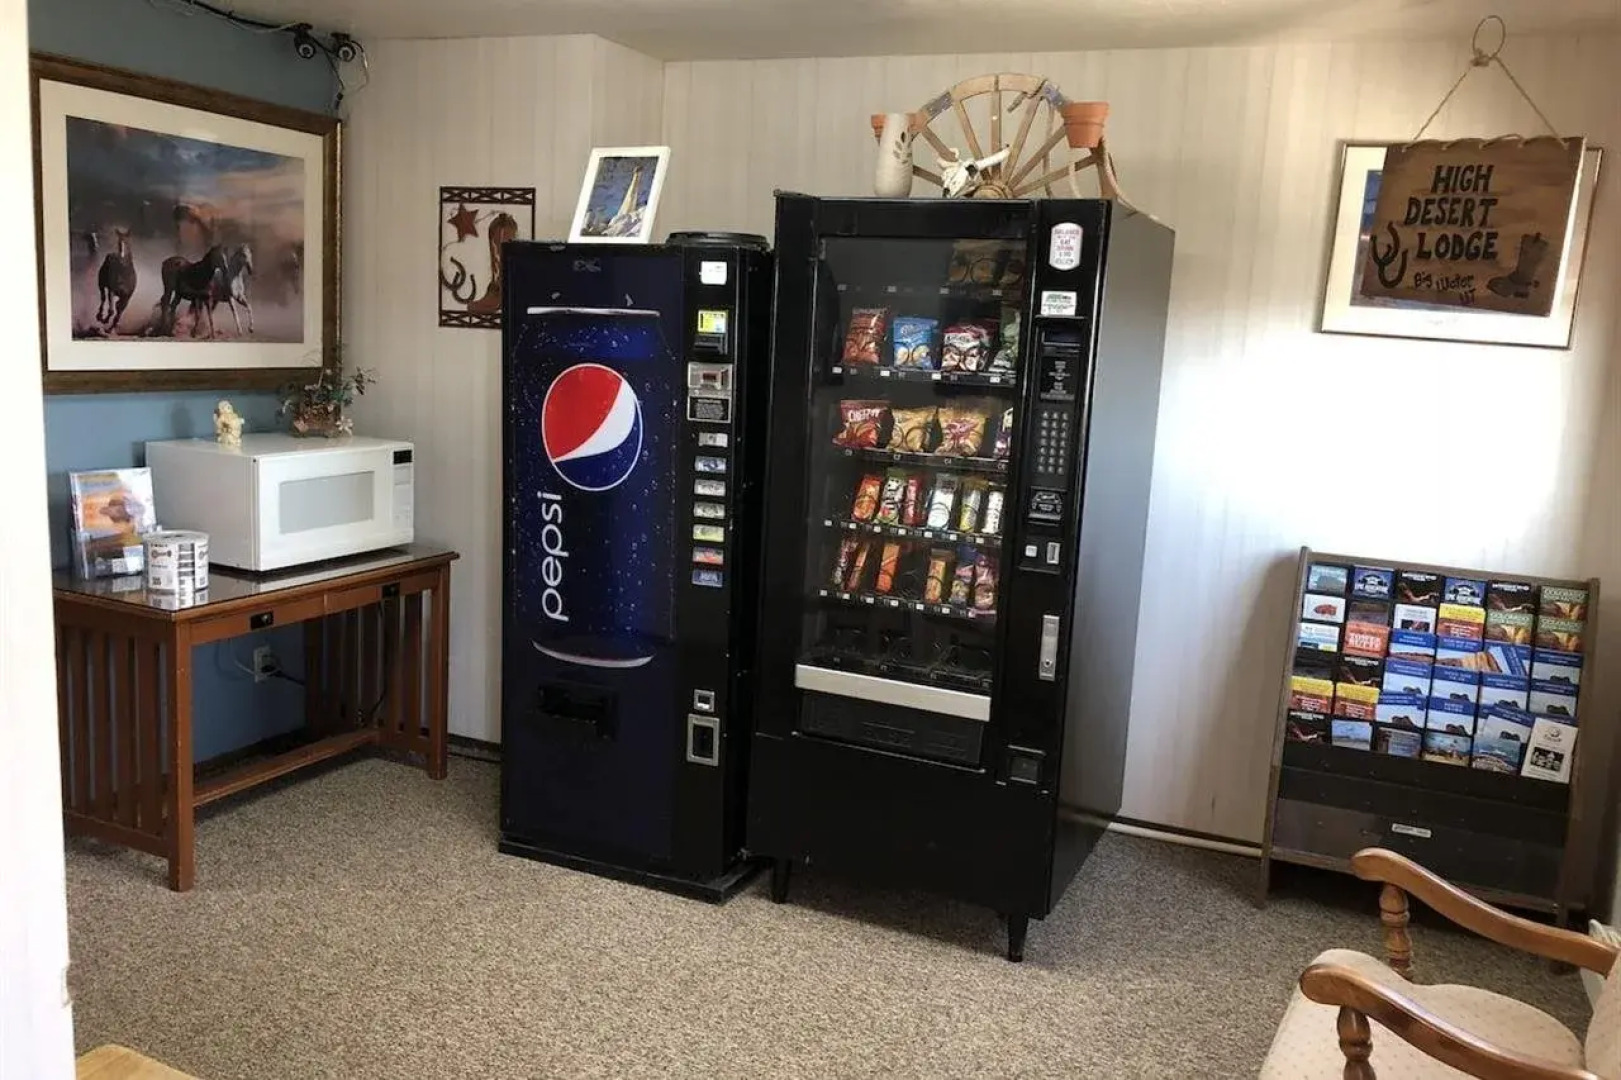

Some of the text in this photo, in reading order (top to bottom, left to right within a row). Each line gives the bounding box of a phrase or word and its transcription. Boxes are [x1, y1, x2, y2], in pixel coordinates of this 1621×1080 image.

[1431, 164, 1495, 193] HIGH
[1404, 197, 1499, 226] DESERT
[1417, 232, 1499, 260] LODGE
[1414, 271, 1432, 289] Big
[537, 491, 569, 621] pepsi
